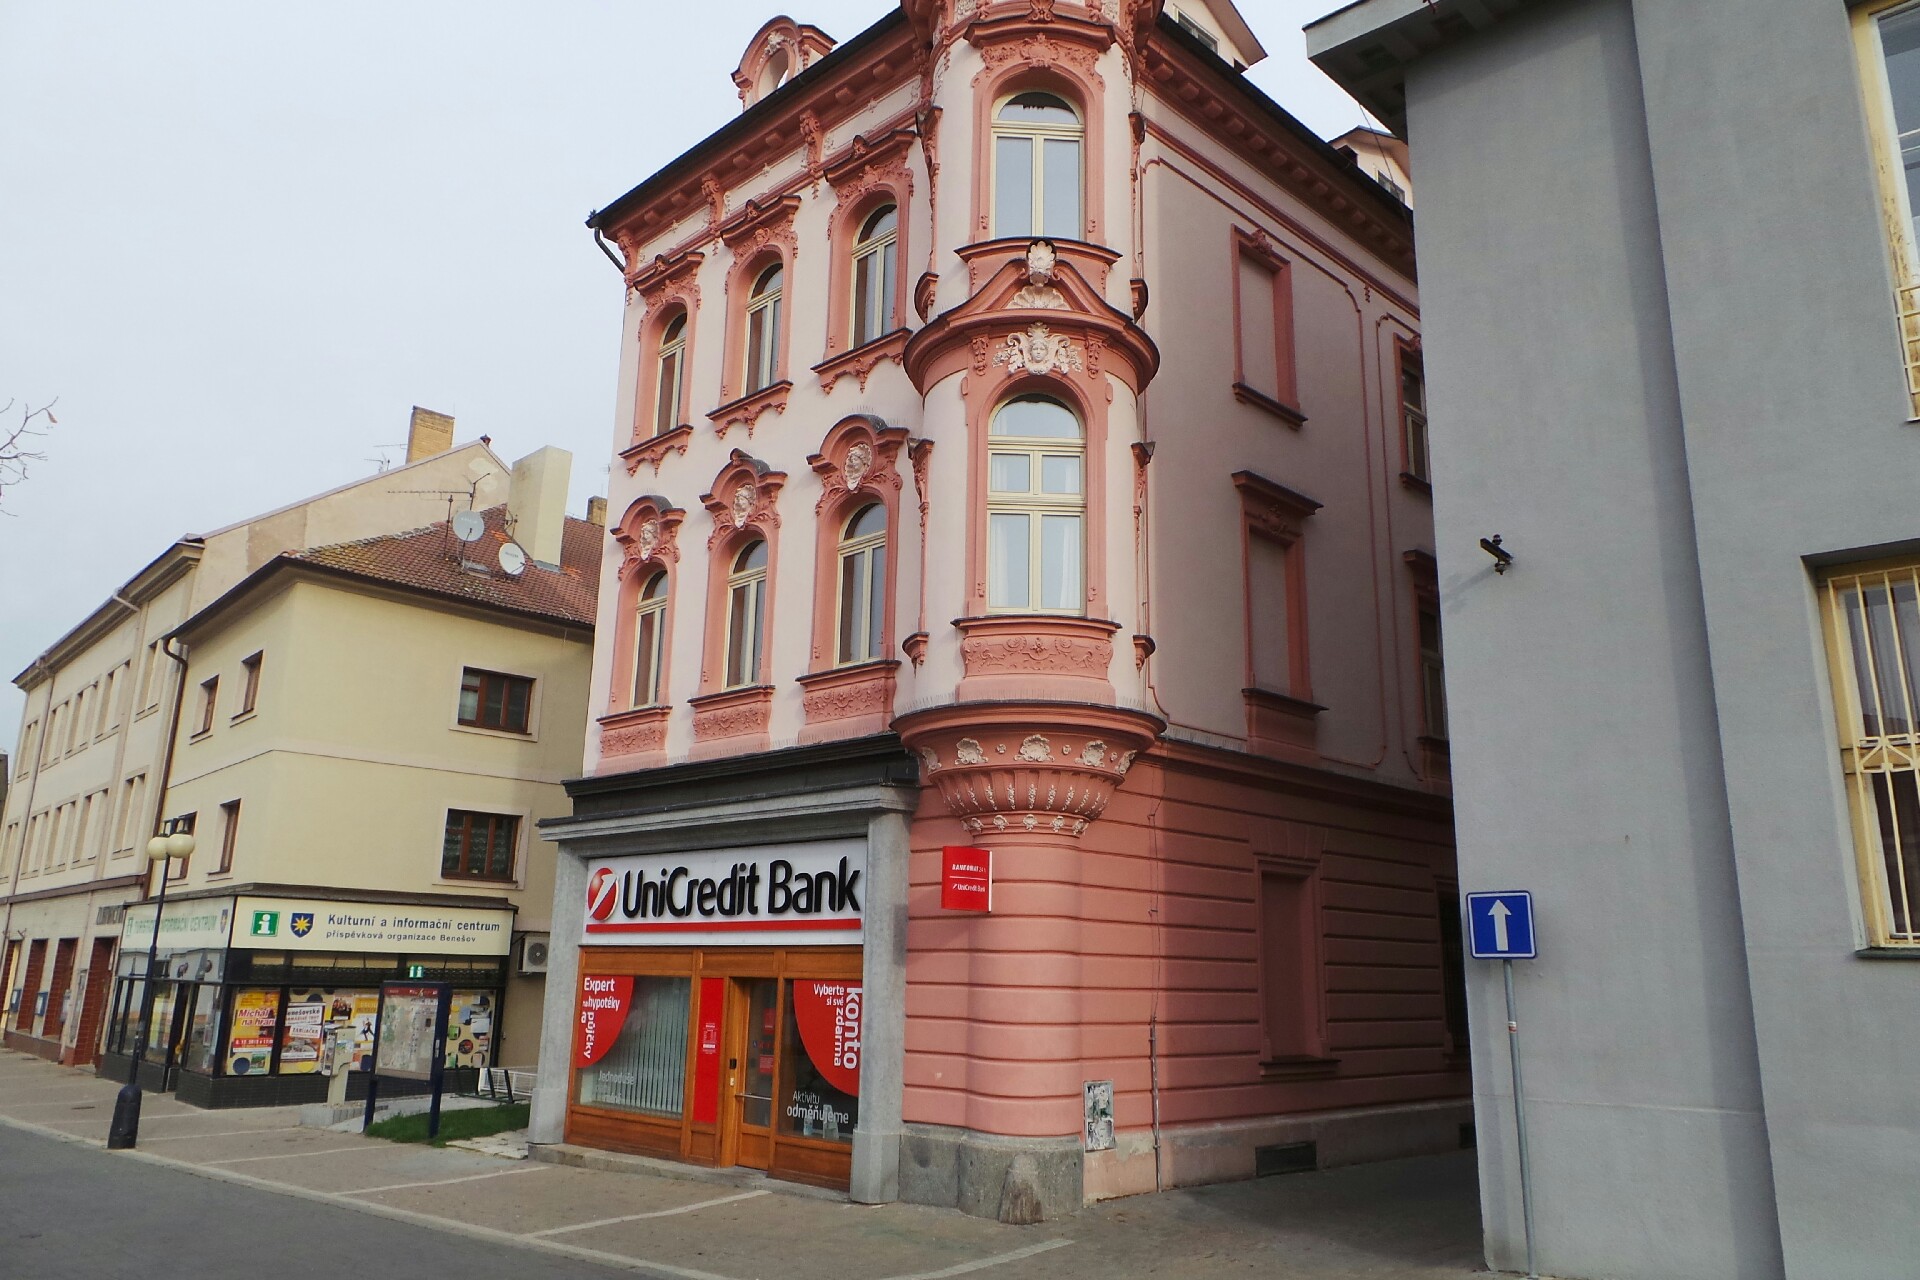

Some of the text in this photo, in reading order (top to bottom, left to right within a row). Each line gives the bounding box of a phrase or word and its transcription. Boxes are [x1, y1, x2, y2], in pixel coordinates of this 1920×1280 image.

[622, 855, 861, 918] UniCredit Bank
[328, 913, 500, 931] Kulturní a informační centrum
[387, 933, 436, 942] organizace
[440, 934, 476, 942] Benešov
[583, 977, 615, 994] Expert
[813, 983, 845, 997] Vyberte
[588, 996, 620, 1012] hypotéky
[826, 996, 844, 1006] si své
[286, 1009, 320, 1017] enešovské
[580, 1011, 587, 1024] a
[583, 1011, 596, 1059] půjčky
[843, 987, 863, 1070] konto
[833, 1007, 845, 1067] zdarma
[599, 1070, 635, 1085] Jednoduše
[792, 1090, 820, 1105] Aktivitu
[786, 1104, 849, 1124] odměňujeme
